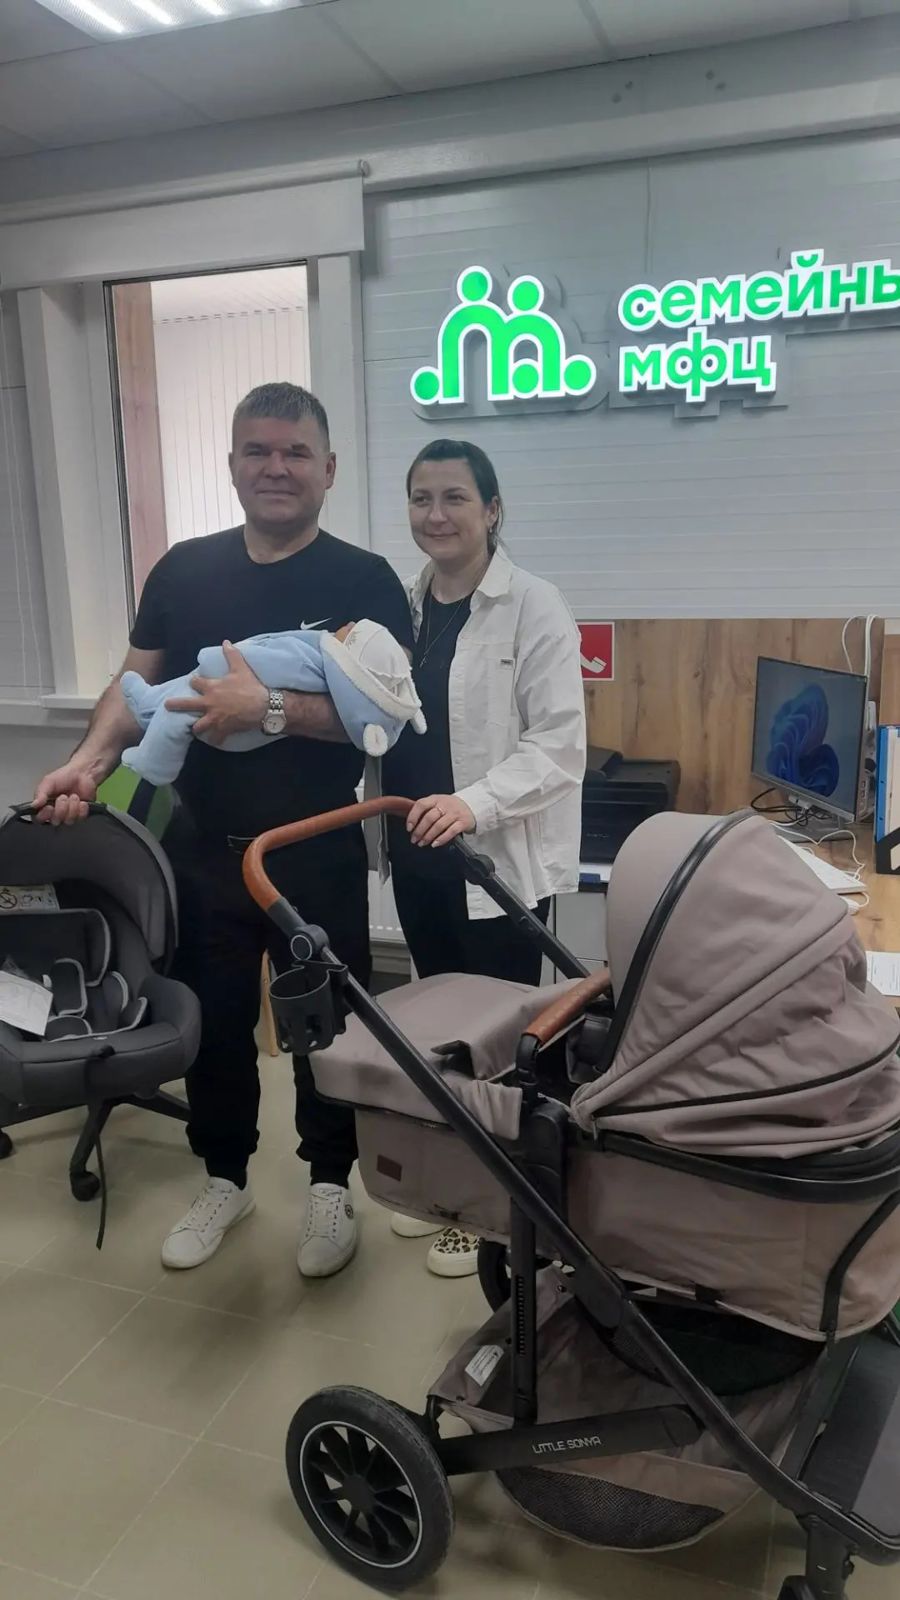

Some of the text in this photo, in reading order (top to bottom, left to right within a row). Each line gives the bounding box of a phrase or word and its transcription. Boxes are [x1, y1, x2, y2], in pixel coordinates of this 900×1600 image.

[620, 328, 776, 401] мфц
[532, 1436, 602, 1454] LITTLE SONYA
